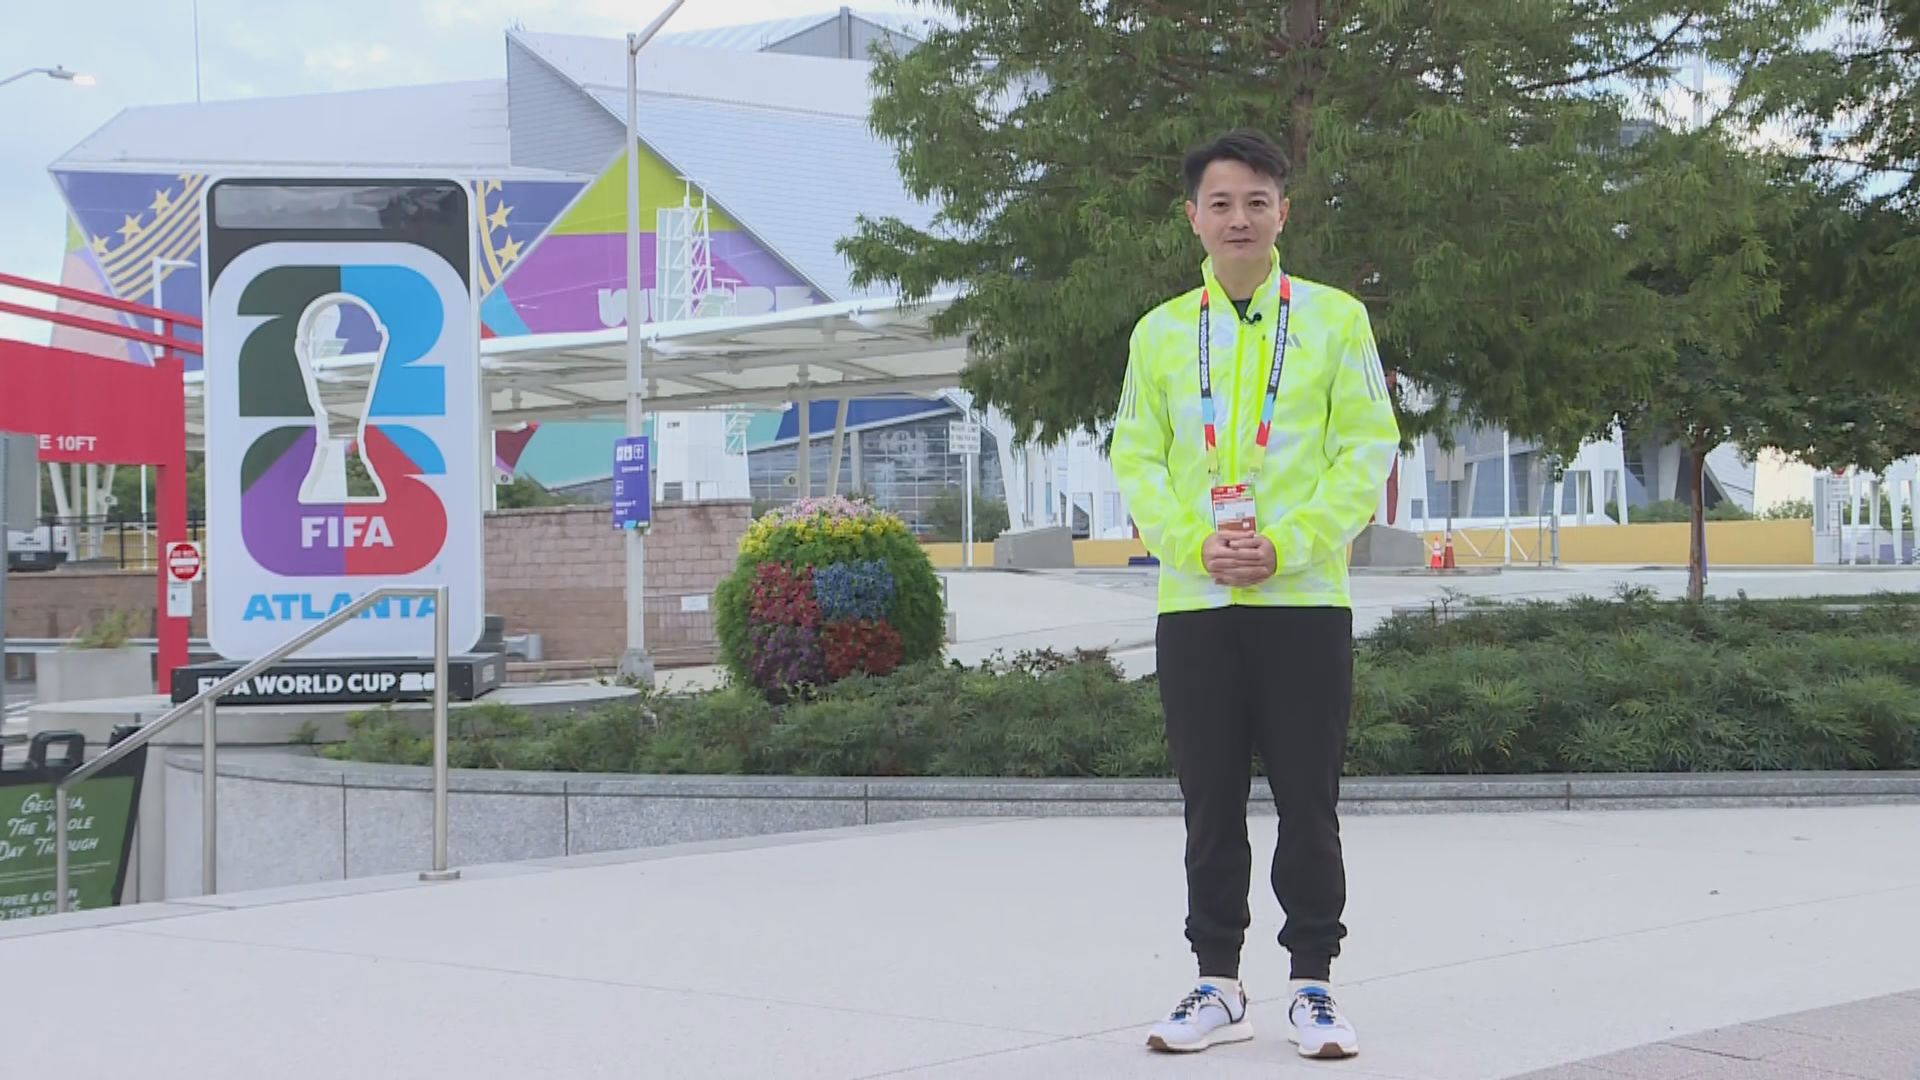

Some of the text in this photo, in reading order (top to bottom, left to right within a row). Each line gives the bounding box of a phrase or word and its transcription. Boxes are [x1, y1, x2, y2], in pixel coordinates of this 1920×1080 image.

[57, 435, 97, 451] 10FT
[301, 516, 395, 547] FIFA
[253, 675, 343, 695] WORLD
[347, 674, 396, 692] CUP
[7, 815, 96, 837] THE WOLE
[0, 840, 27, 861] DAY
